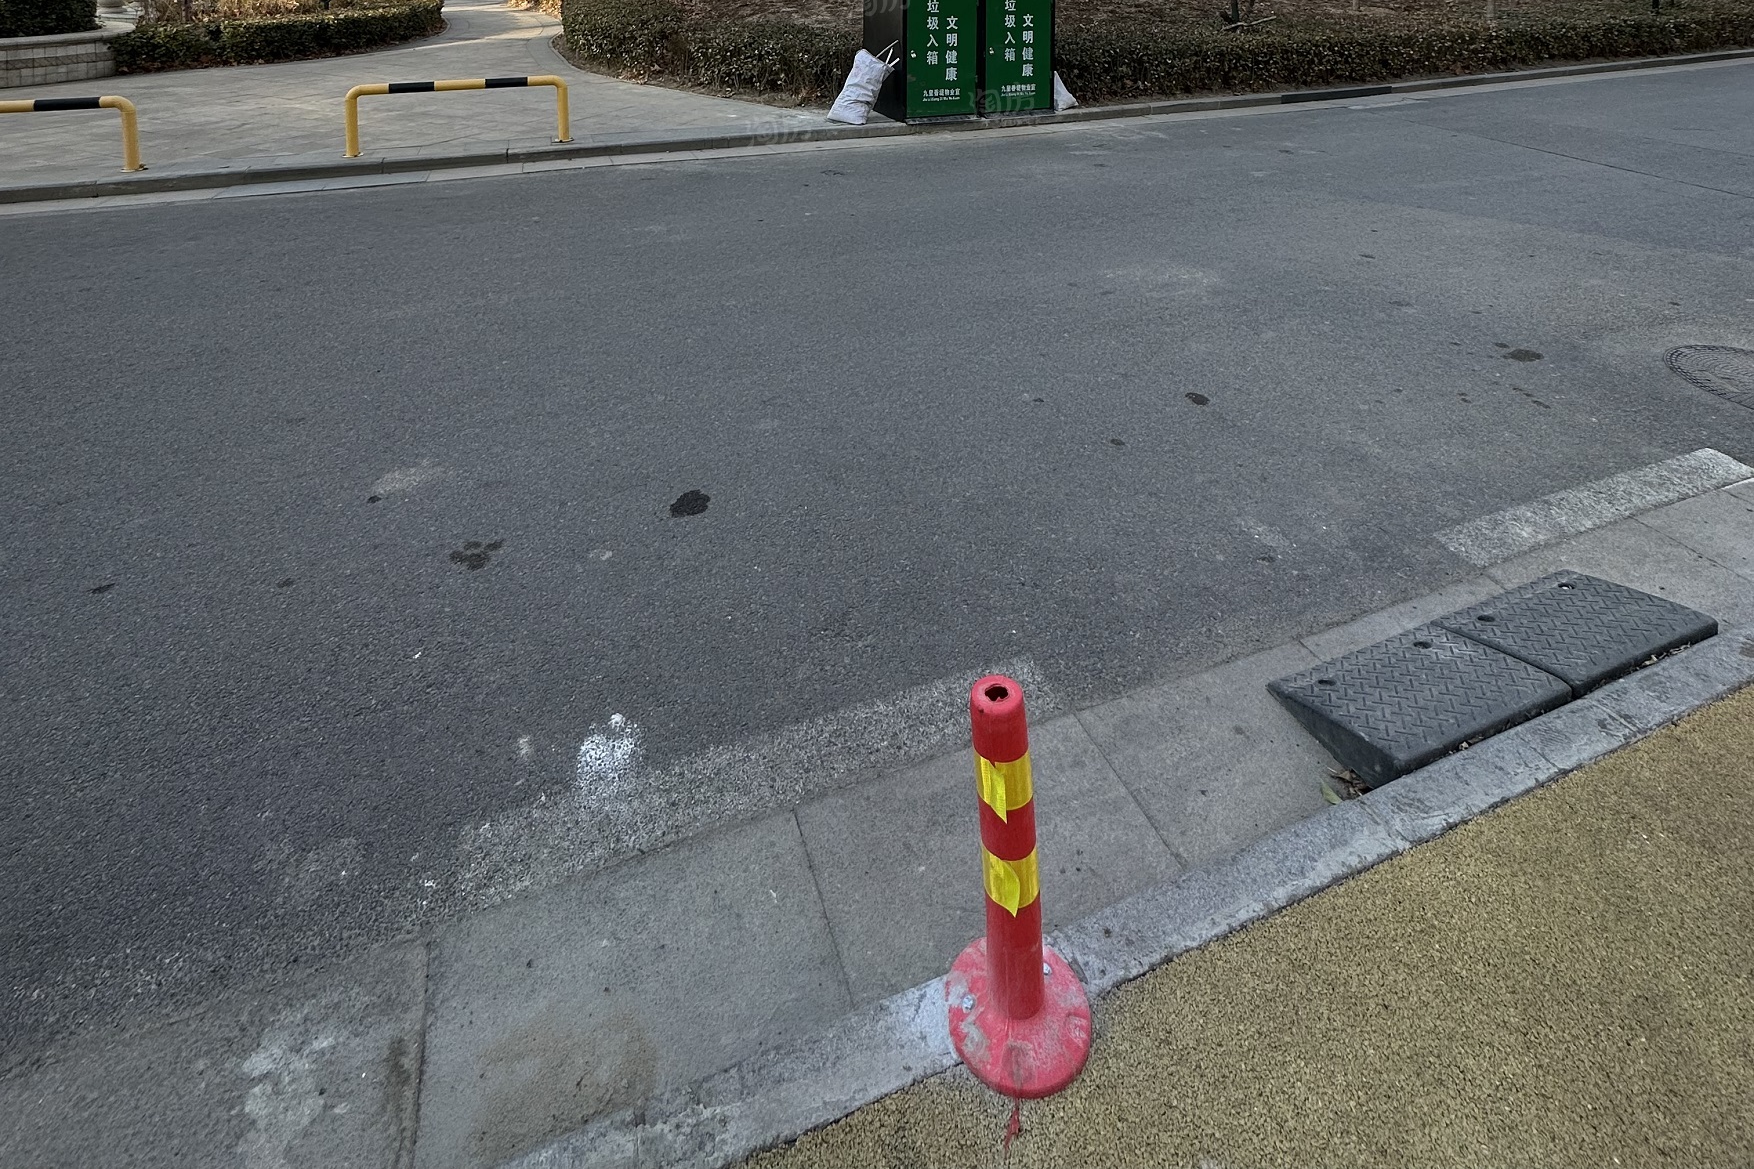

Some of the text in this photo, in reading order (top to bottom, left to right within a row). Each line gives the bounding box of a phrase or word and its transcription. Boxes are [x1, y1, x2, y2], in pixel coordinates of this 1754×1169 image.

[927, 0, 940, 65] 垃圾入箱
[945, 15, 959, 81] 文明健康
[1022, 14, 1034, 77] 文明健康
